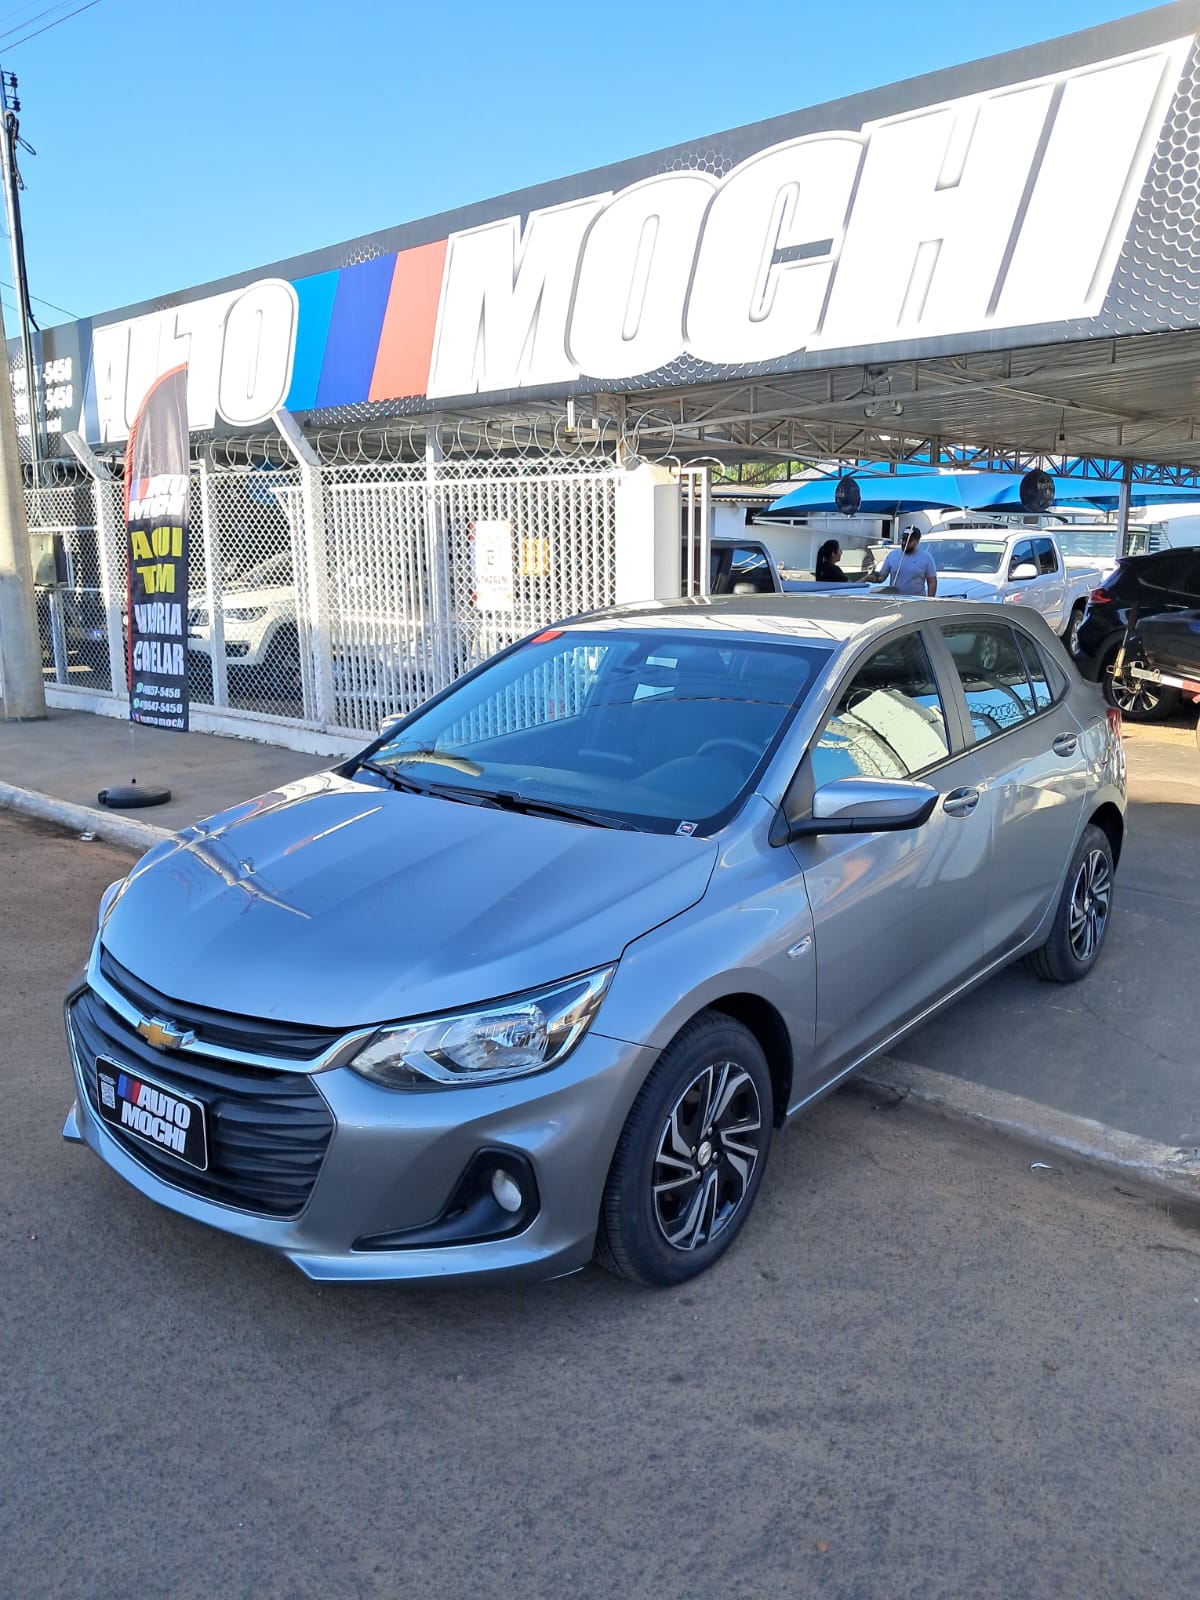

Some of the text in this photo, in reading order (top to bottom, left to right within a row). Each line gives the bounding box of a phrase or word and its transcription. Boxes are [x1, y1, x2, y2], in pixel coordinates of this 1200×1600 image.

[77, 35, 1196, 444] AUTO MOCHI
[121, 1101, 187, 1154] MOCHI
[136, 1084, 191, 1129] AUTO
